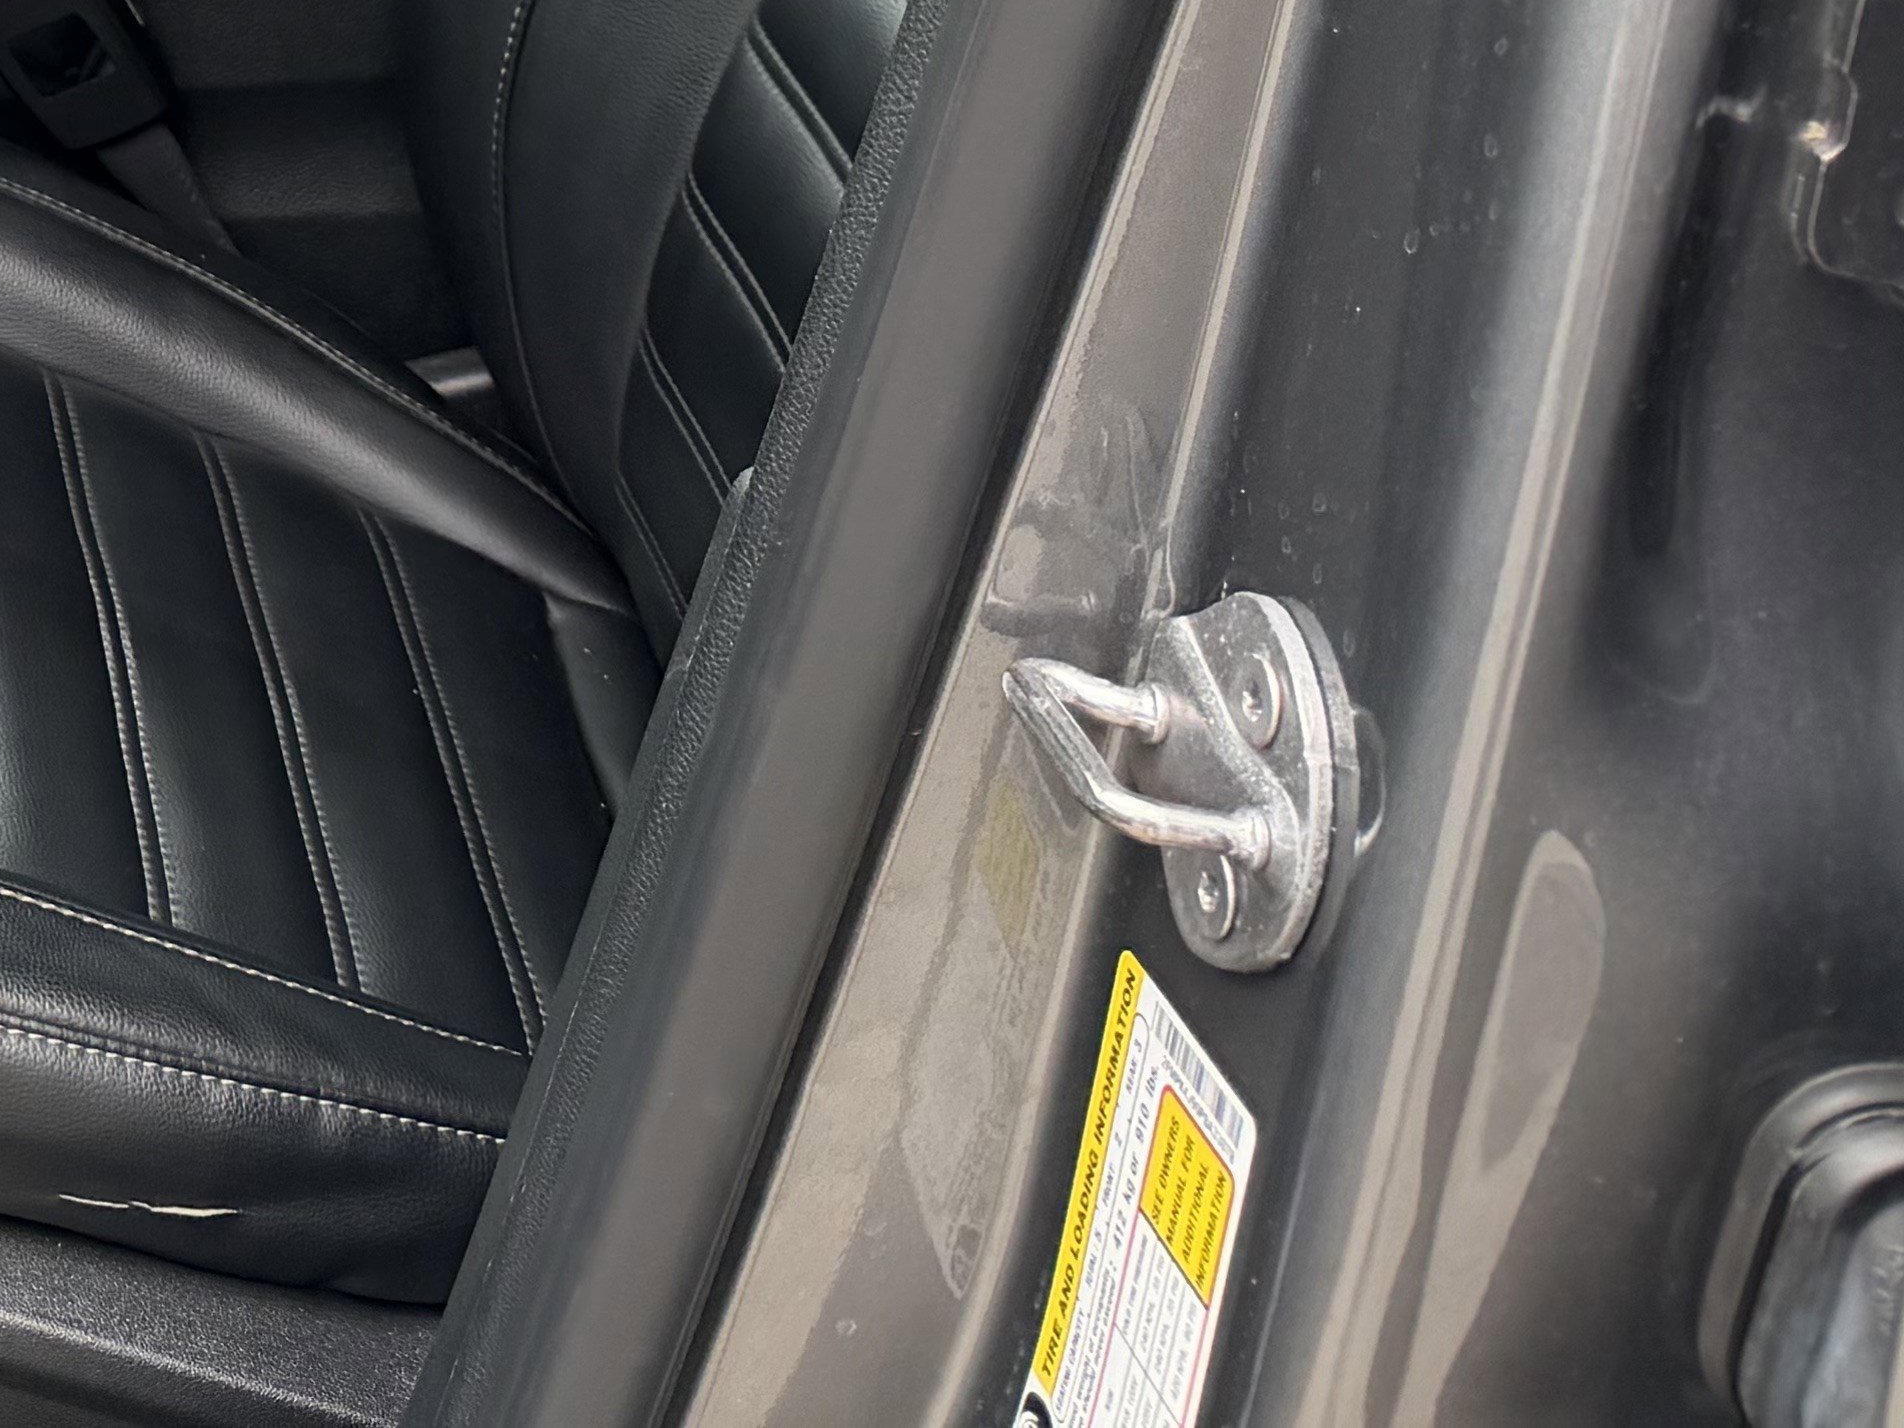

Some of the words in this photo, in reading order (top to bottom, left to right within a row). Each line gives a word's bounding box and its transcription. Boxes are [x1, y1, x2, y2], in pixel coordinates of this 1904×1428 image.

[1040, 1318, 1064, 1378] TIRE
[1058, 1264, 1076, 1319] AND
[1068, 1149, 1100, 1260] LOADING
[1093, 967, 1138, 1147] INFORMATION
[1150, 1187, 1166, 1225] SEE
[1158, 1115, 1181, 1189] OWNERS
[1165, 1176, 1188, 1247] MANUAL
[1182, 1133, 1196, 1173] FOR
[1183, 1162, 1211, 1265] ADDITIONAL
[1194, 1168, 1229, 1291] INFORMATION
